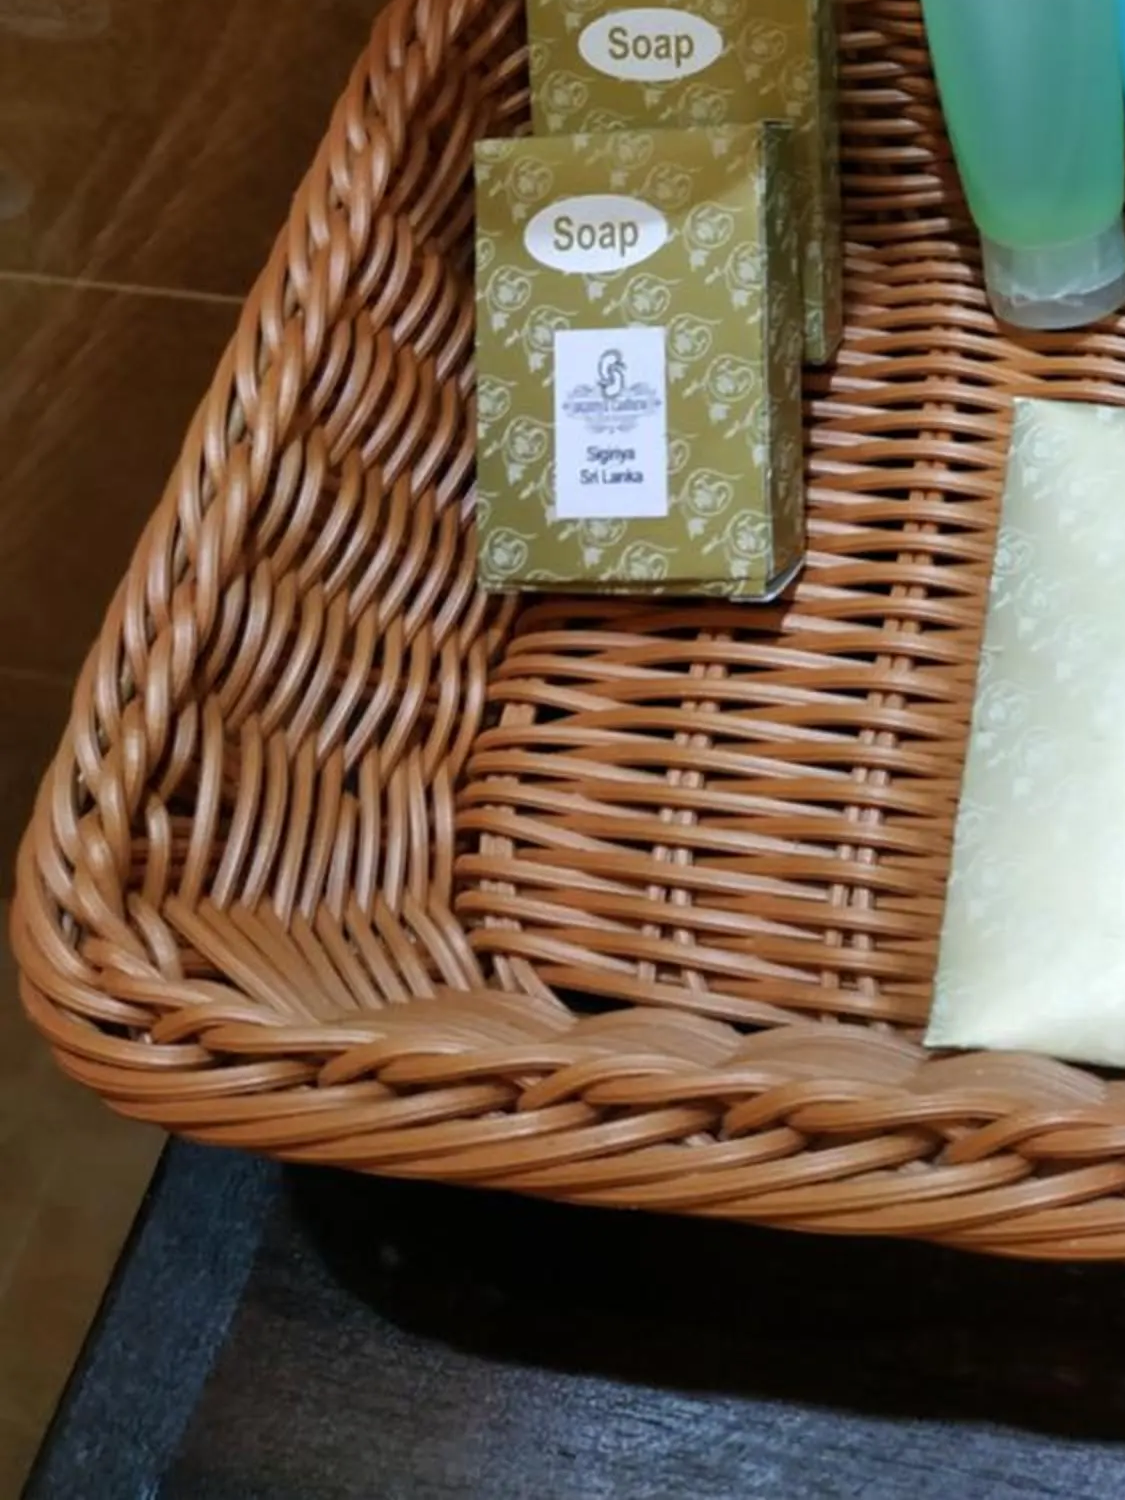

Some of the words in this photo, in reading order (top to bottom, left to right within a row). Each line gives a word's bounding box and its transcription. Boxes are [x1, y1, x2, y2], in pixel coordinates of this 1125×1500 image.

[608, 27, 694, 68] Soap
[553, 216, 639, 257] Soap
[580, 469, 600, 485] Sri
[602, 468, 644, 484] Lanka
